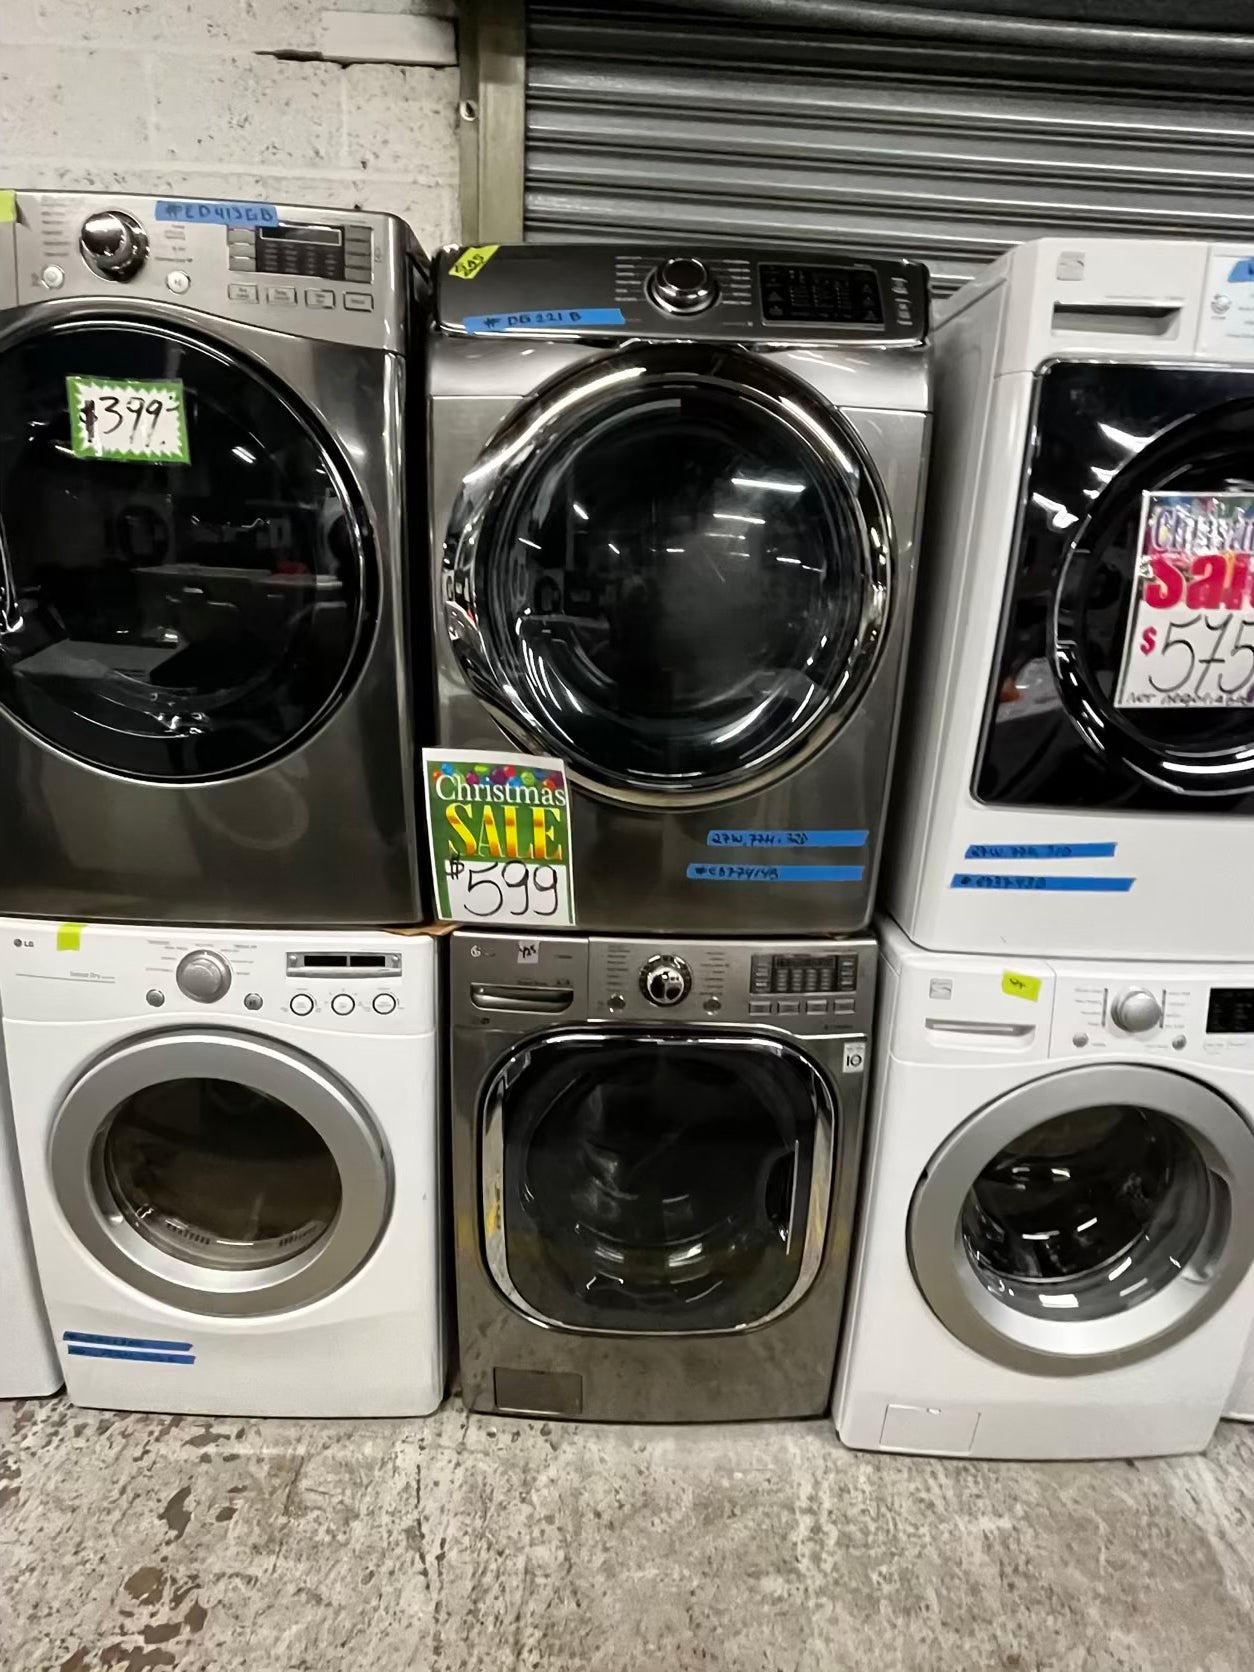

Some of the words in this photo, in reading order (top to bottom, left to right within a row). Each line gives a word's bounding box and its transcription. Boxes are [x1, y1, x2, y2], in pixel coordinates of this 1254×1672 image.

[435, 773, 566, 806] Christmas
[445, 802, 562, 861] SALE
[23, 940, 35, 948] LG
